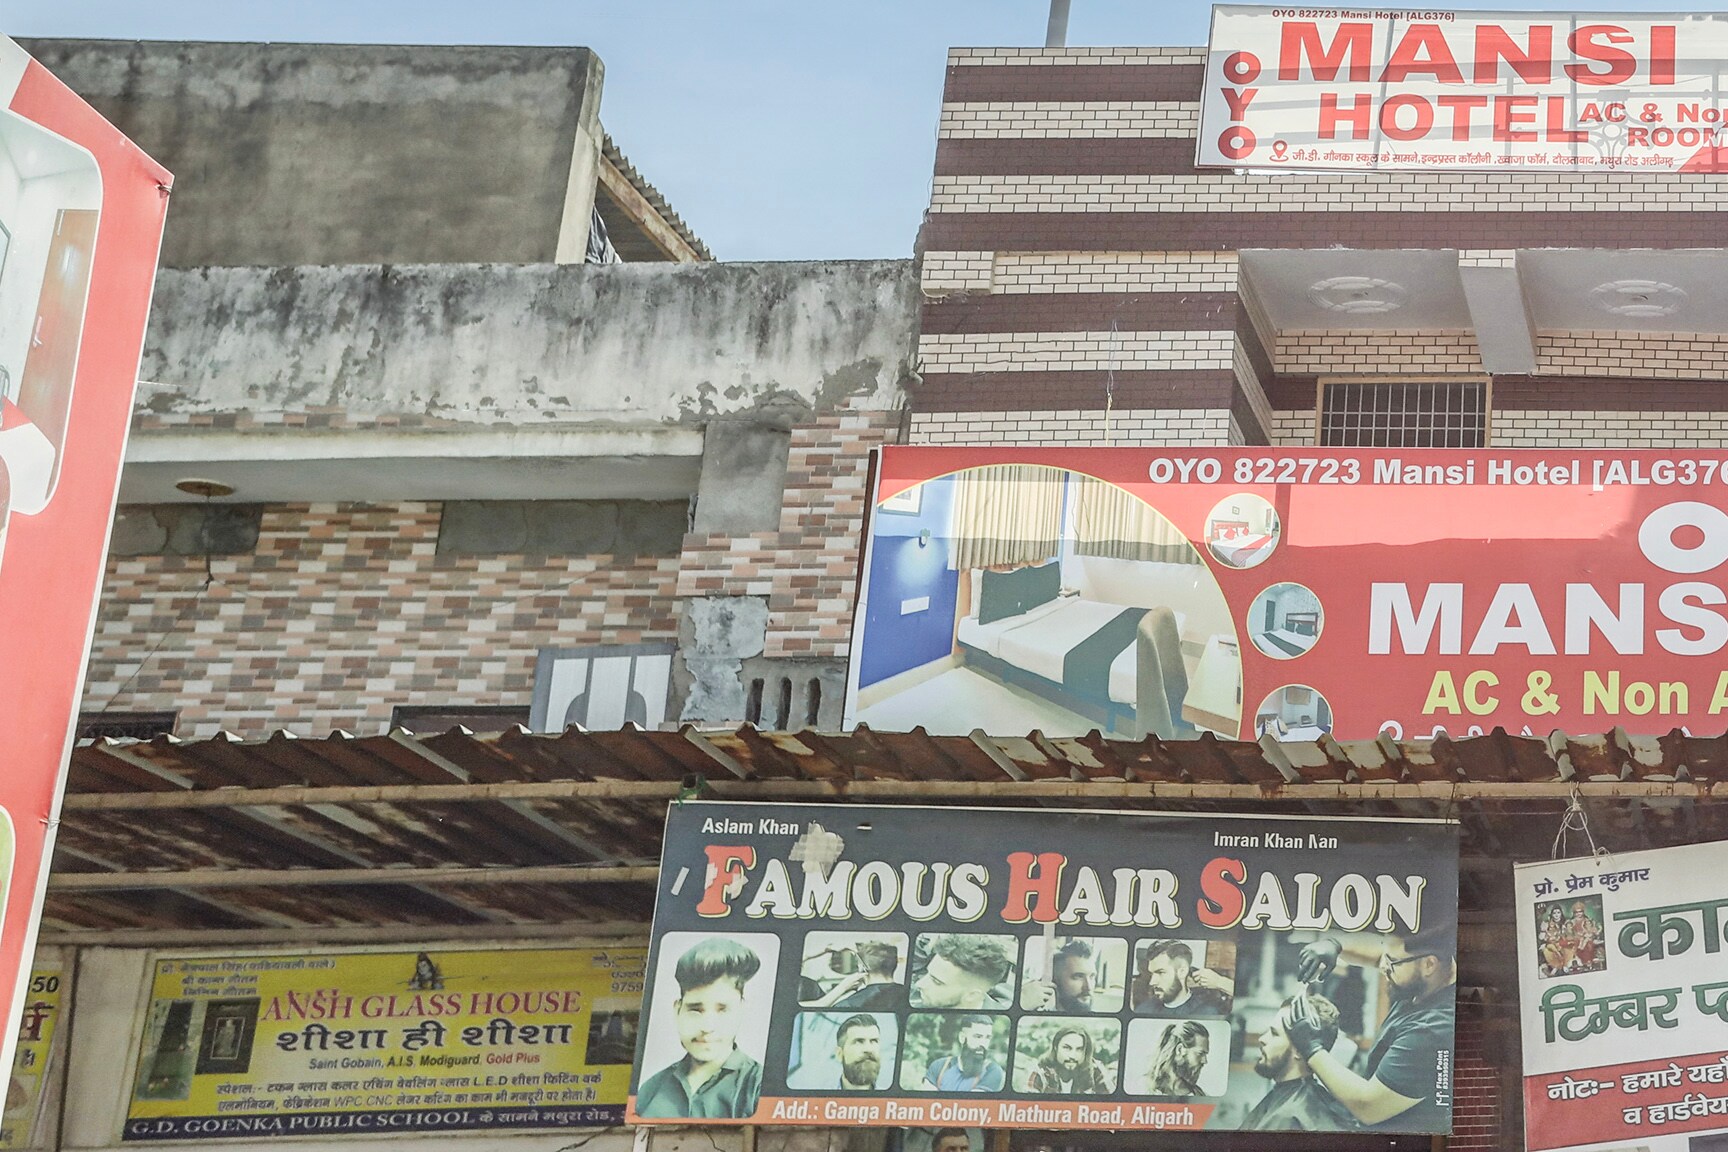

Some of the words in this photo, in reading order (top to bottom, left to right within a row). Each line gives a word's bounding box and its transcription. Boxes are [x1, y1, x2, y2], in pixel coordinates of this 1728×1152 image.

[1299, 10, 1338, 18] 822723
[1341, 11, 1371, 19] Mansi
[1375, 11, 1403, 20] Hotel
[1406, 12, 1455, 22] [ALG376]
[1277, 20, 1677, 87] MANSI
[1217, 51, 1262, 160] OYO
[1317, 92, 1591, 143] HOTEL
[1579, 103, 1627, 123] AC
[1639, 103, 1663, 123] &
[1356, 153, 1379, 166] स्कूल
[1381, 151, 1390, 163] के
[1148, 458, 1222, 485] OYO
[1233, 458, 1362, 485] 822723
[1373, 458, 1474, 485] Mansi
[1487, 458, 1579, 486] Hotel
[1421, 670, 1500, 716] AC
[1520, 670, 1561, 716] &
[1582, 670, 1689, 716] Non
[702, 817, 753, 835] Aslam
[758, 819, 799, 836] Khan
[1214, 832, 1259, 847] Imran
[1264, 833, 1303, 848] Khan
[1533, 878, 1559, 898] प्रो.
[1565, 874, 1594, 893] प्रेम
[1599, 867, 1650, 892] कुमार
[28, 976, 59, 993] 50
[360, 992, 462, 1019] GLASS
[468, 990, 582, 1015] HOUSE
[1538, 983, 1684, 1044] टिम्बर
[276, 1023, 388, 1051] शीशा
[401, 1020, 447, 1050] ही
[461, 1018, 573, 1046] शीशा
[309, 1059, 337, 1070] Saint
[486, 1052, 513, 1065] Gold
[516, 1052, 540, 1064] Plus
[1621, 1062, 1684, 1094] हमारे
[334, 1095, 362, 1107] WPC
[366, 1094, 393, 1106] CNC
[772, 1100, 819, 1121] Add.:
[825, 1102, 880, 1124] Ganga
[884, 1102, 923, 1121] Ram
[929, 1104, 992, 1126] Colony,
[998, 1105, 1072, 1124] Mathura
[1077, 1106, 1126, 1126] Road,
[1131, 1107, 1194, 1127] Aligarh
[131, 1120, 178, 1135] G.D.
[184, 1118, 285, 1133] GOENKA
[288, 1114, 373, 1129] PUBLIC
[376, 1111, 476, 1127] SCHOOL
[1622, 1106, 1642, 1125] व
